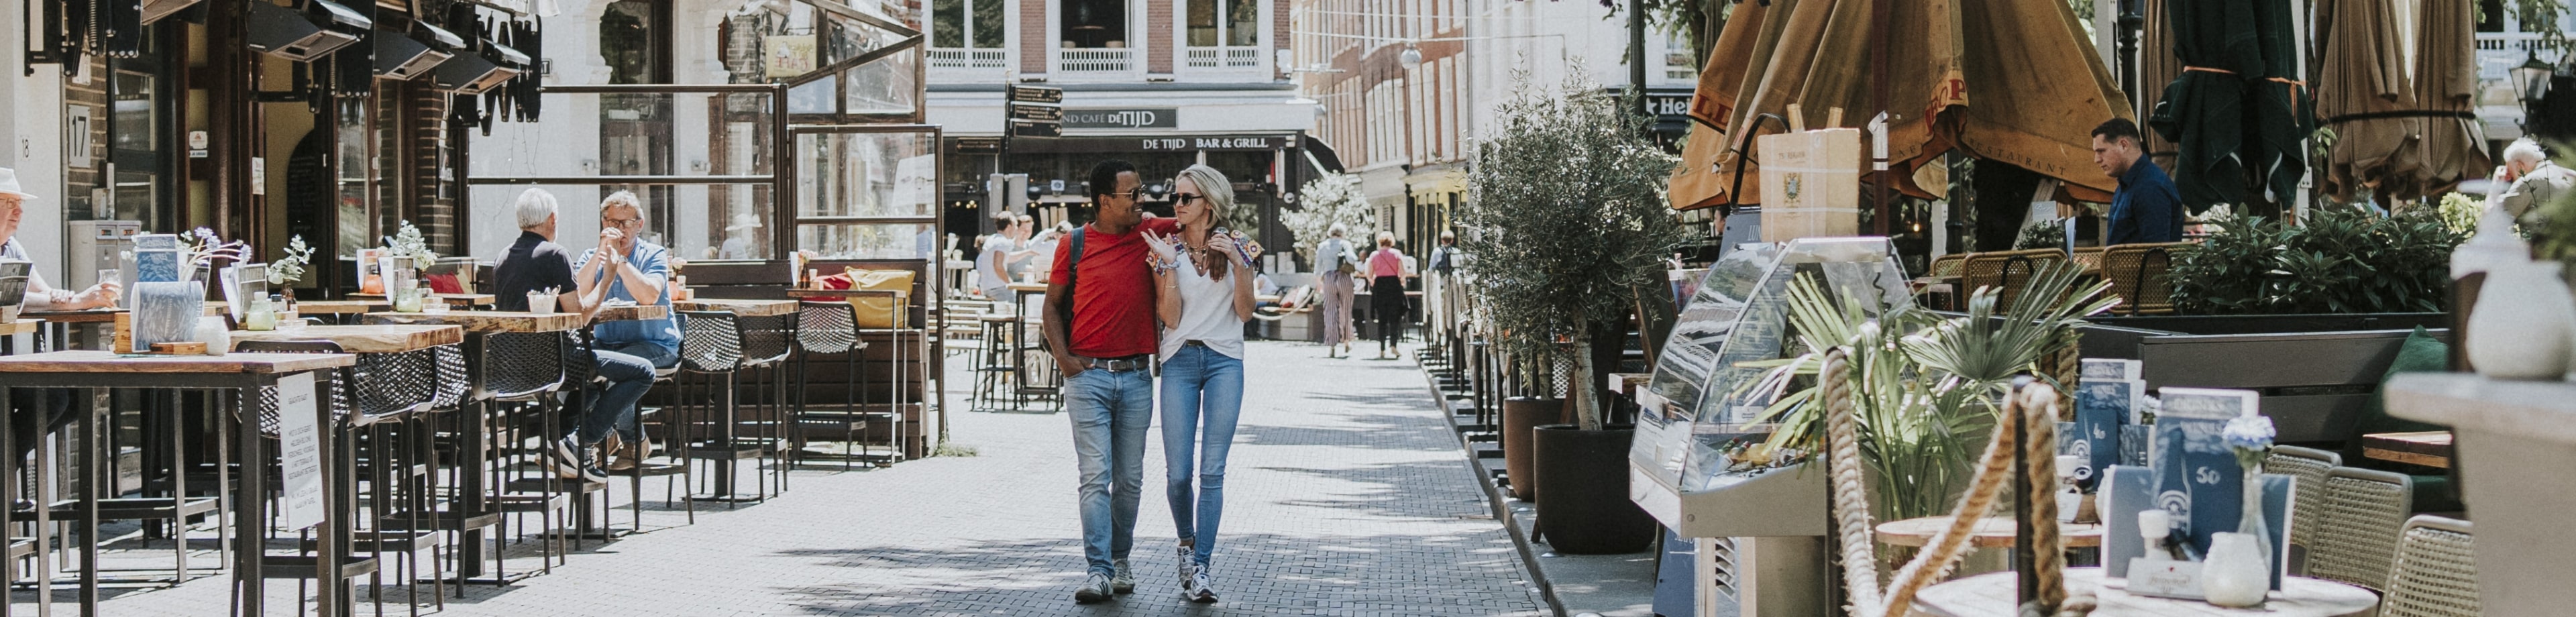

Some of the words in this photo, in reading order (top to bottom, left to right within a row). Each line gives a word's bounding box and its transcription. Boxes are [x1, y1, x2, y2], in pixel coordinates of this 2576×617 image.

[1062, 115, 1079, 123] ND
[1081, 113, 1105, 123] CAFÉ
[72, 115, 87, 157] 17
[1143, 139, 1159, 150] DE
[1161, 138, 1186, 151] TIJD
[1195, 138, 1220, 148] BAR
[1222, 138, 1232, 148] &
[1233, 138, 1269, 148] GRILL
[21, 138, 30, 158] 18
[1969, 137, 2066, 176] RESTAURANT
